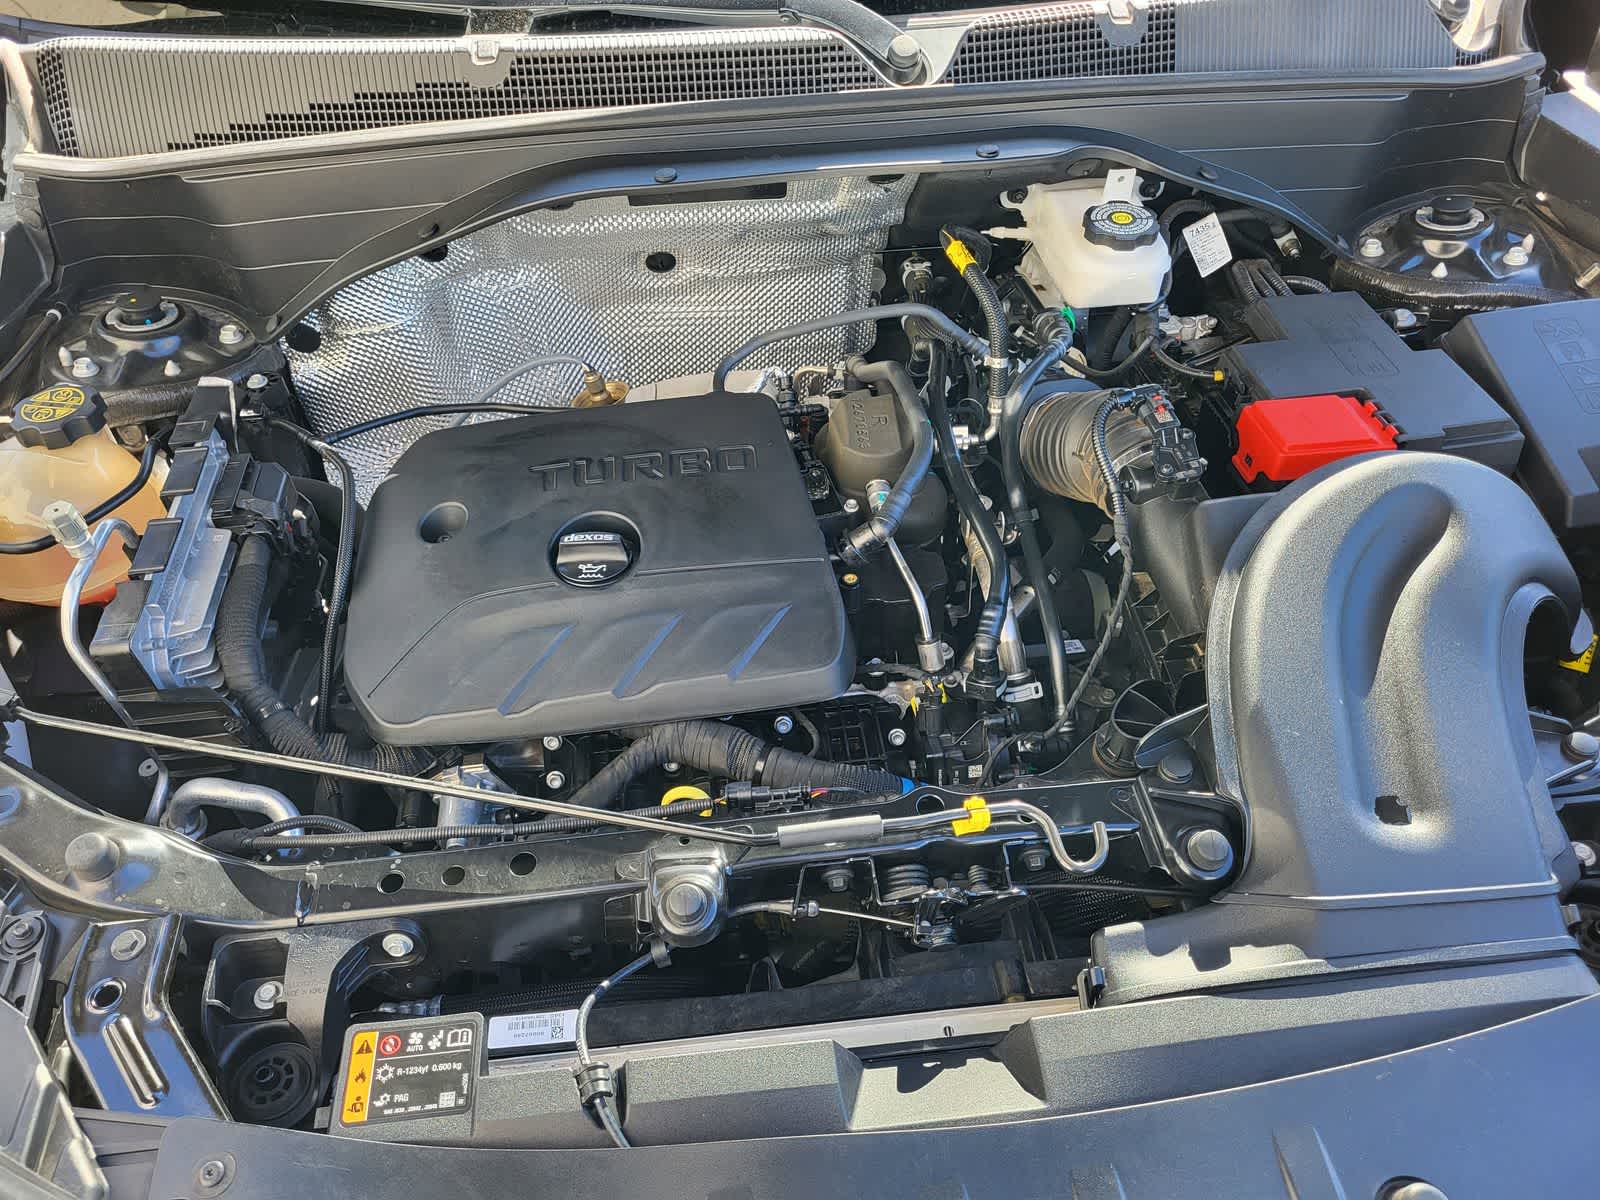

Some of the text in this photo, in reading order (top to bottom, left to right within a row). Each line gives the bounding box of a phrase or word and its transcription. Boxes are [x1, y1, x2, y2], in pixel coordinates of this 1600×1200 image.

[528, 444, 757, 491] TURBO
[564, 532, 613, 542] dexos
[406, 1044, 423, 1053] AUTO
[396, 1064, 429, 1077] R-1234yf
[452, 1062, 462, 1071] kg
[393, 1092, 409, 1103] PAG
